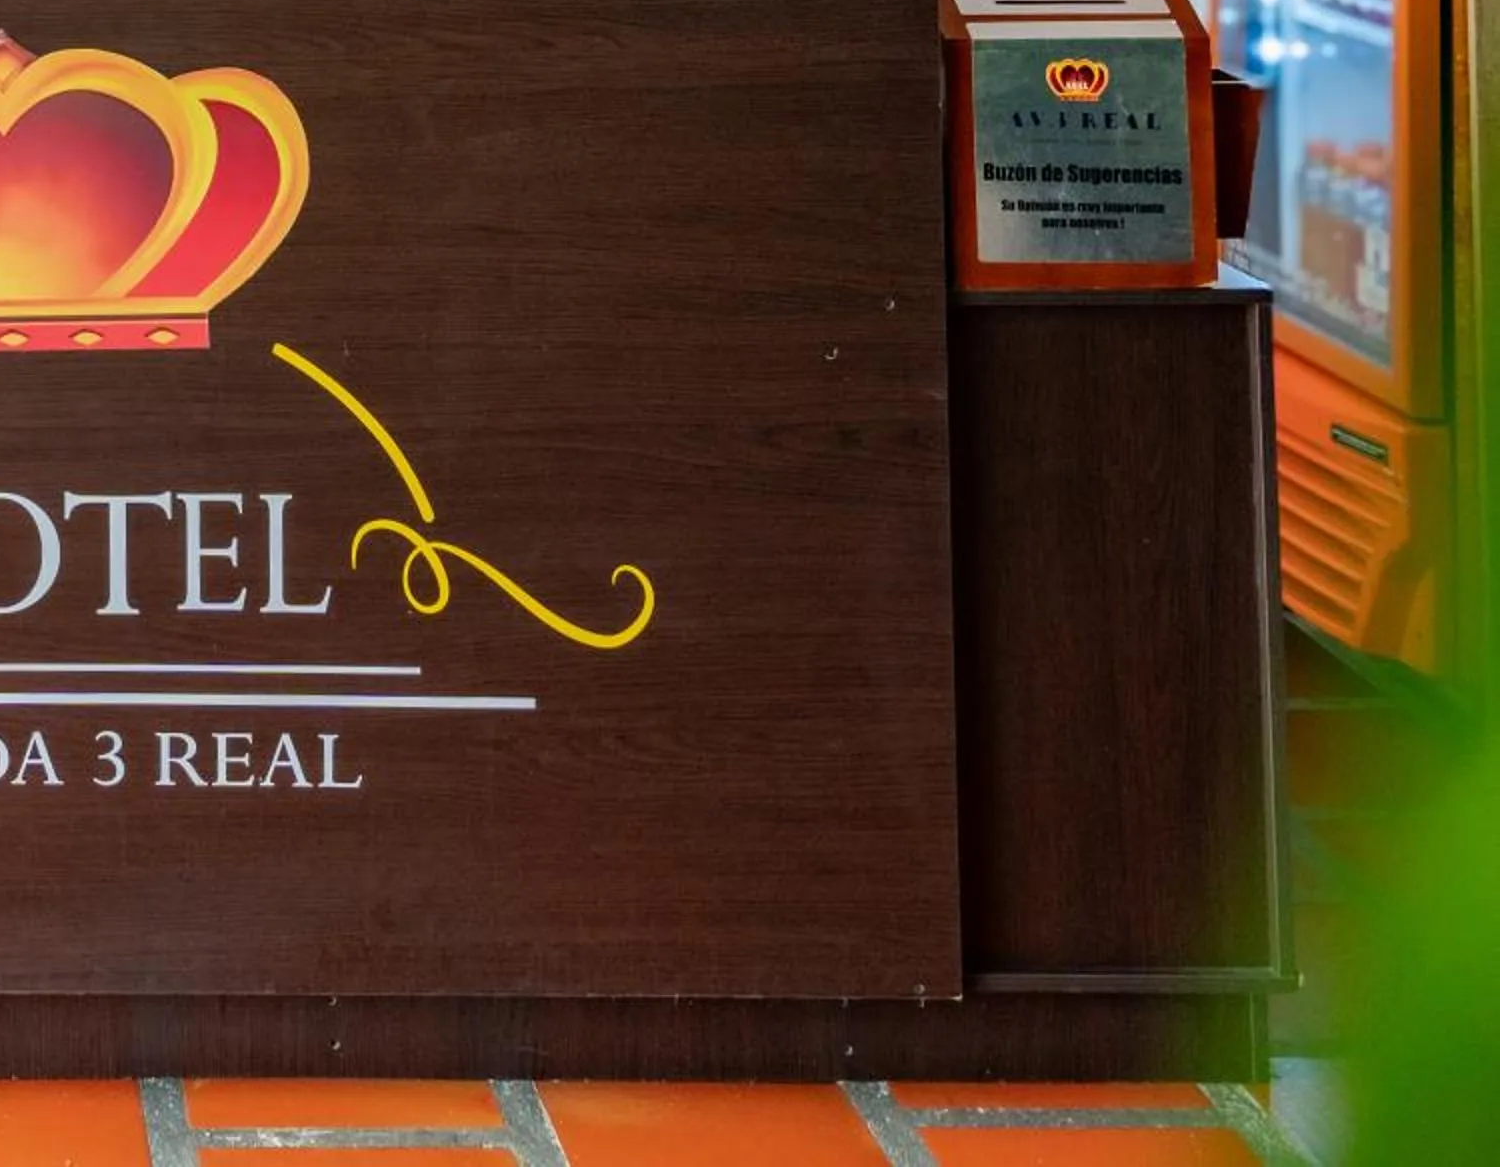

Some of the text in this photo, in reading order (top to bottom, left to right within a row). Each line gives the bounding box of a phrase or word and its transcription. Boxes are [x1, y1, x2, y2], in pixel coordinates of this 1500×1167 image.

[1080, 112, 1162, 131] REAL
[1041, 164, 1064, 183] de
[1066, 164, 1184, 187] Sugerencias
[93, 730, 127, 788] 3
[155, 731, 364, 789] REAL
